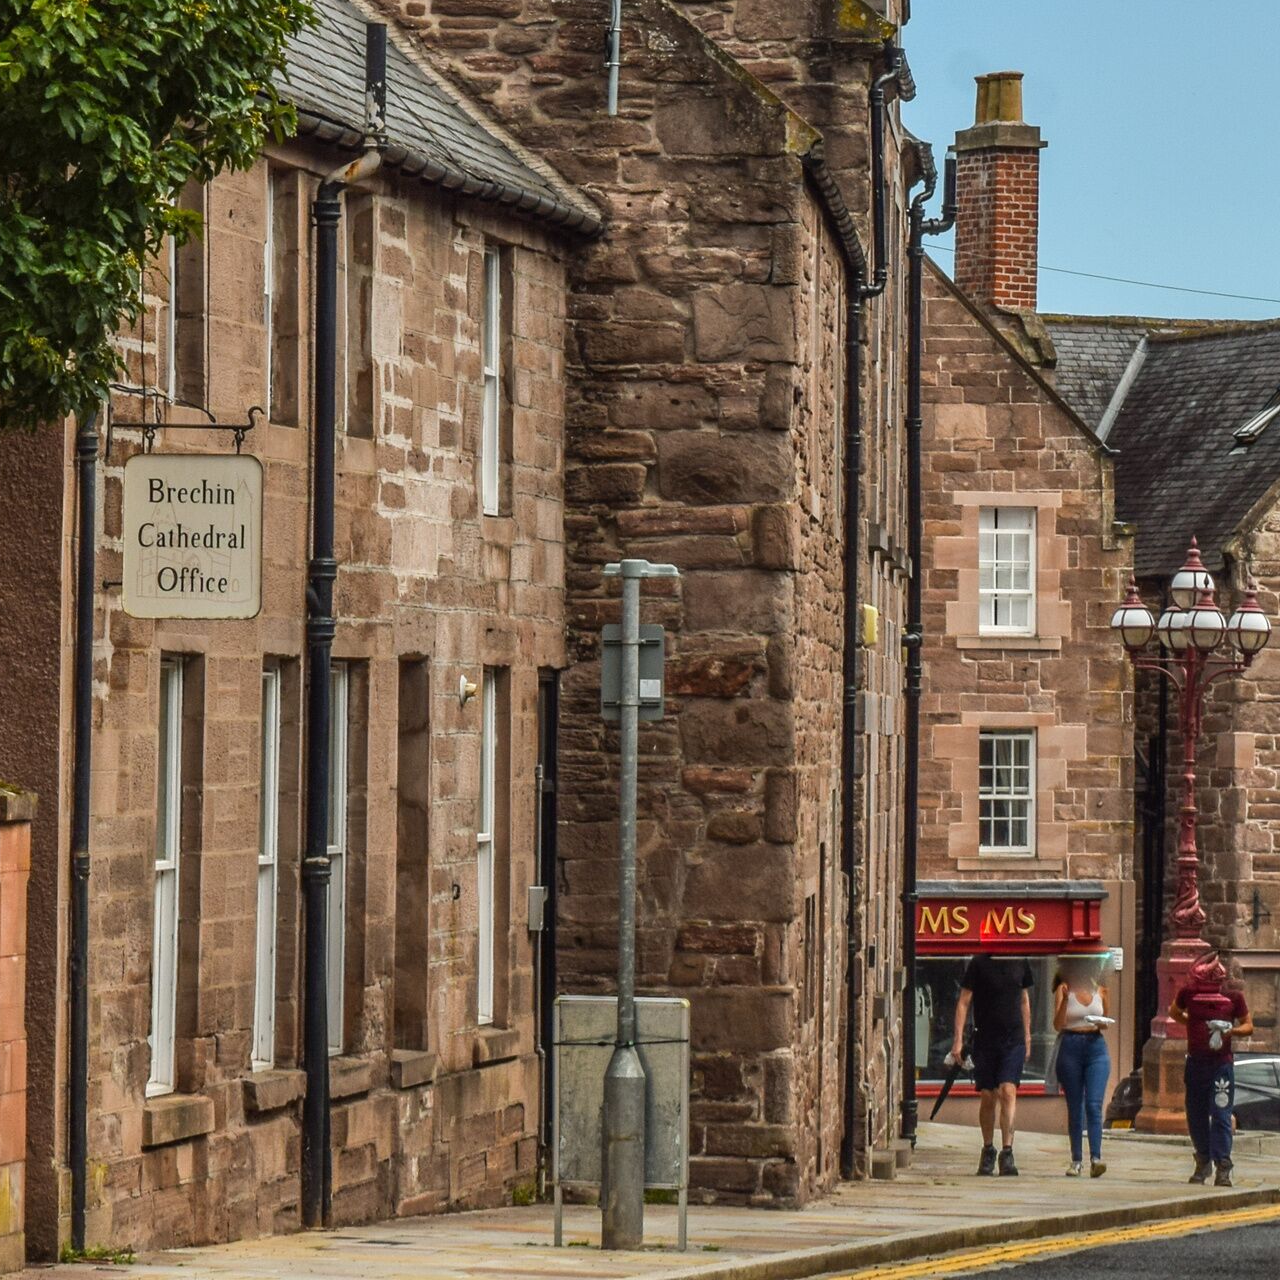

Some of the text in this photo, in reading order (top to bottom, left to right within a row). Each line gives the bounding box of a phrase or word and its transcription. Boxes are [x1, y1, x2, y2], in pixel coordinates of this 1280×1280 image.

[148, 478, 235, 505] Brechin
[138, 522, 245, 549] Cathedral
[157, 566, 228, 593] Office
[915, 905, 1036, 935] MS MS
